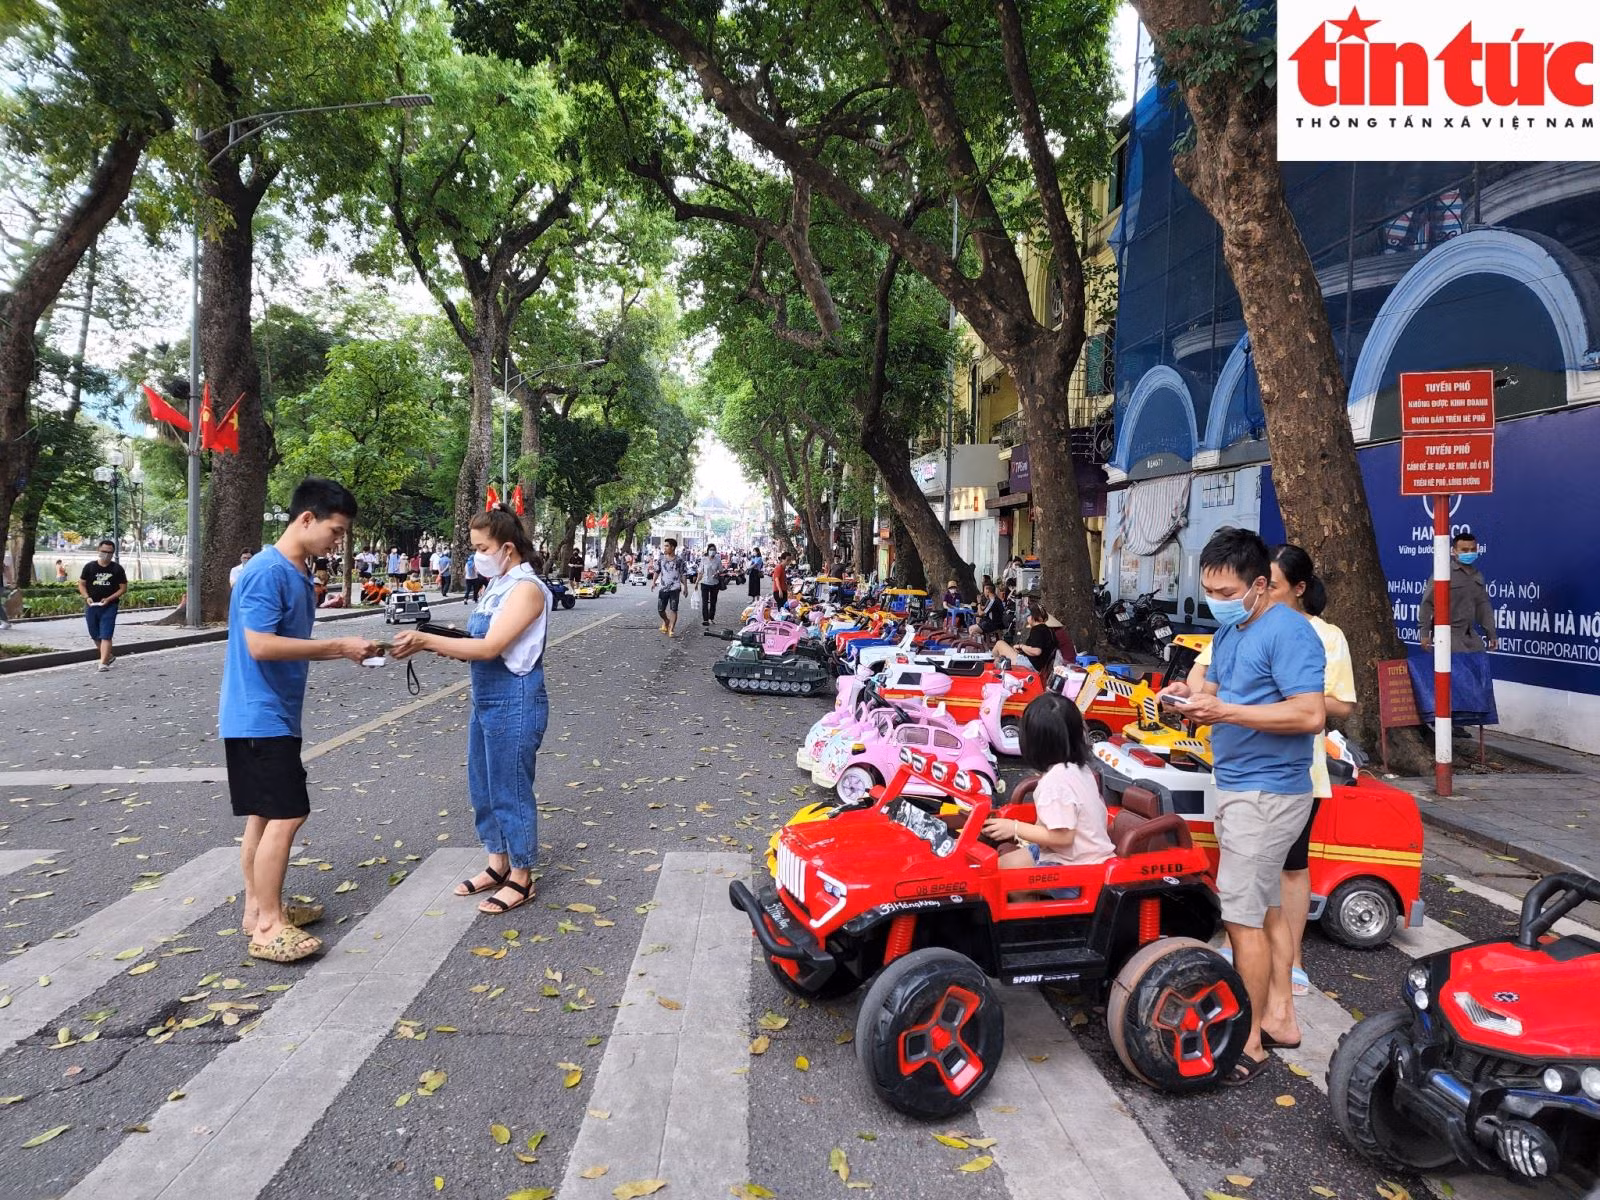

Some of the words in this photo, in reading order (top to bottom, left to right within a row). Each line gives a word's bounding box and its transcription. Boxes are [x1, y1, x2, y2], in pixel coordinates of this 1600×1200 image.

[1425, 381, 1452, 392] TUYẾN
[1453, 380, 1471, 392] PHỐ
[1425, 443, 1452, 456] TUYẾN
[1453, 441, 1471, 454] PHỐ
[1388, 579, 1413, 594] NHÂN
[1414, 580, 1428, 595] DÂ
[1499, 581, 1515, 599] HÀ
[1518, 581, 1540, 603] NỘI
[1392, 598, 1408, 622] ẦU
[1494, 604, 1516, 630] IỂN
[1519, 607, 1550, 633] NHÀ
[1554, 610, 1576, 636] HÀ
[1580, 609, 1600, 643] NỘ
[1142, 863, 1183, 875] SPEED
[930, 881, 967, 892] SPEED
[1012, 974, 1043, 984] SPORT
